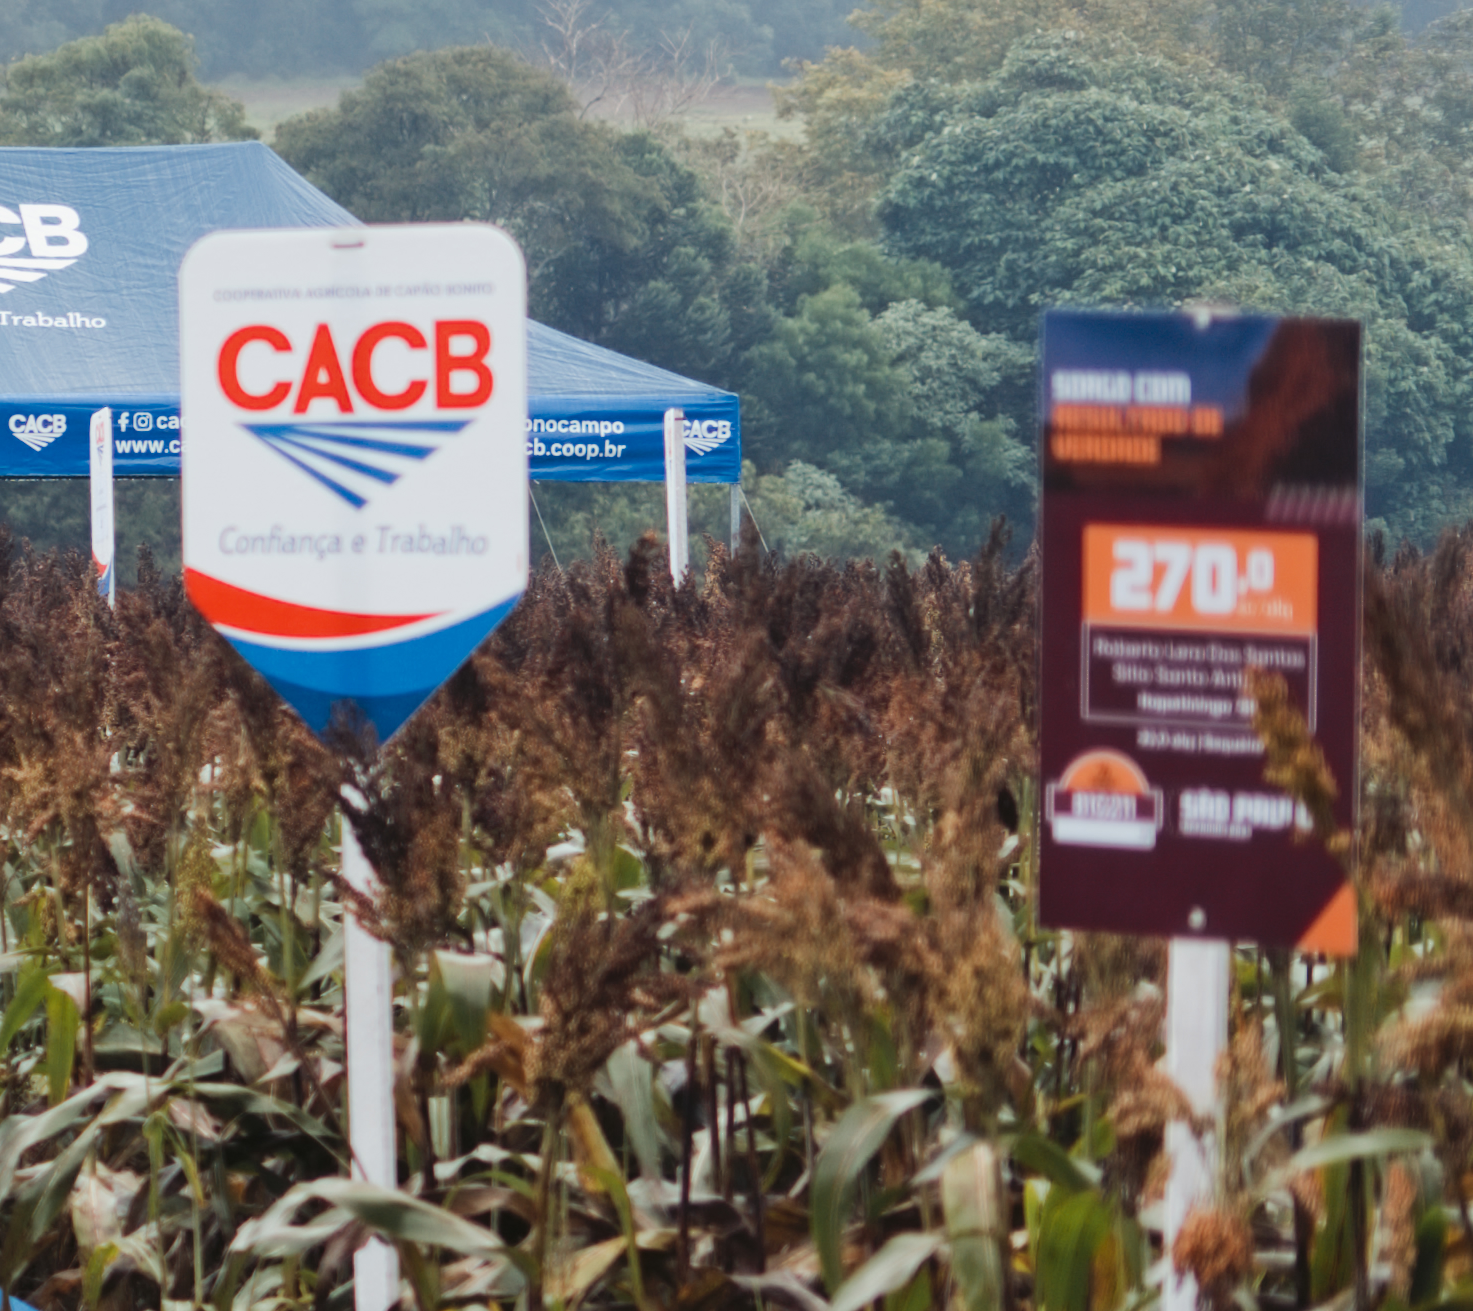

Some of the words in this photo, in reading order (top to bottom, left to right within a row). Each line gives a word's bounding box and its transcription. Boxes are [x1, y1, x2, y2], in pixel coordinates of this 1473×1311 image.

[375, 286, 391, 297] DE
[218, 320, 493, 414] CACB
[9, 414, 67, 433] CACB
[219, 527, 341, 559] Confiança
[351, 533, 365, 553] e
[377, 527, 487, 555] Trabalho
